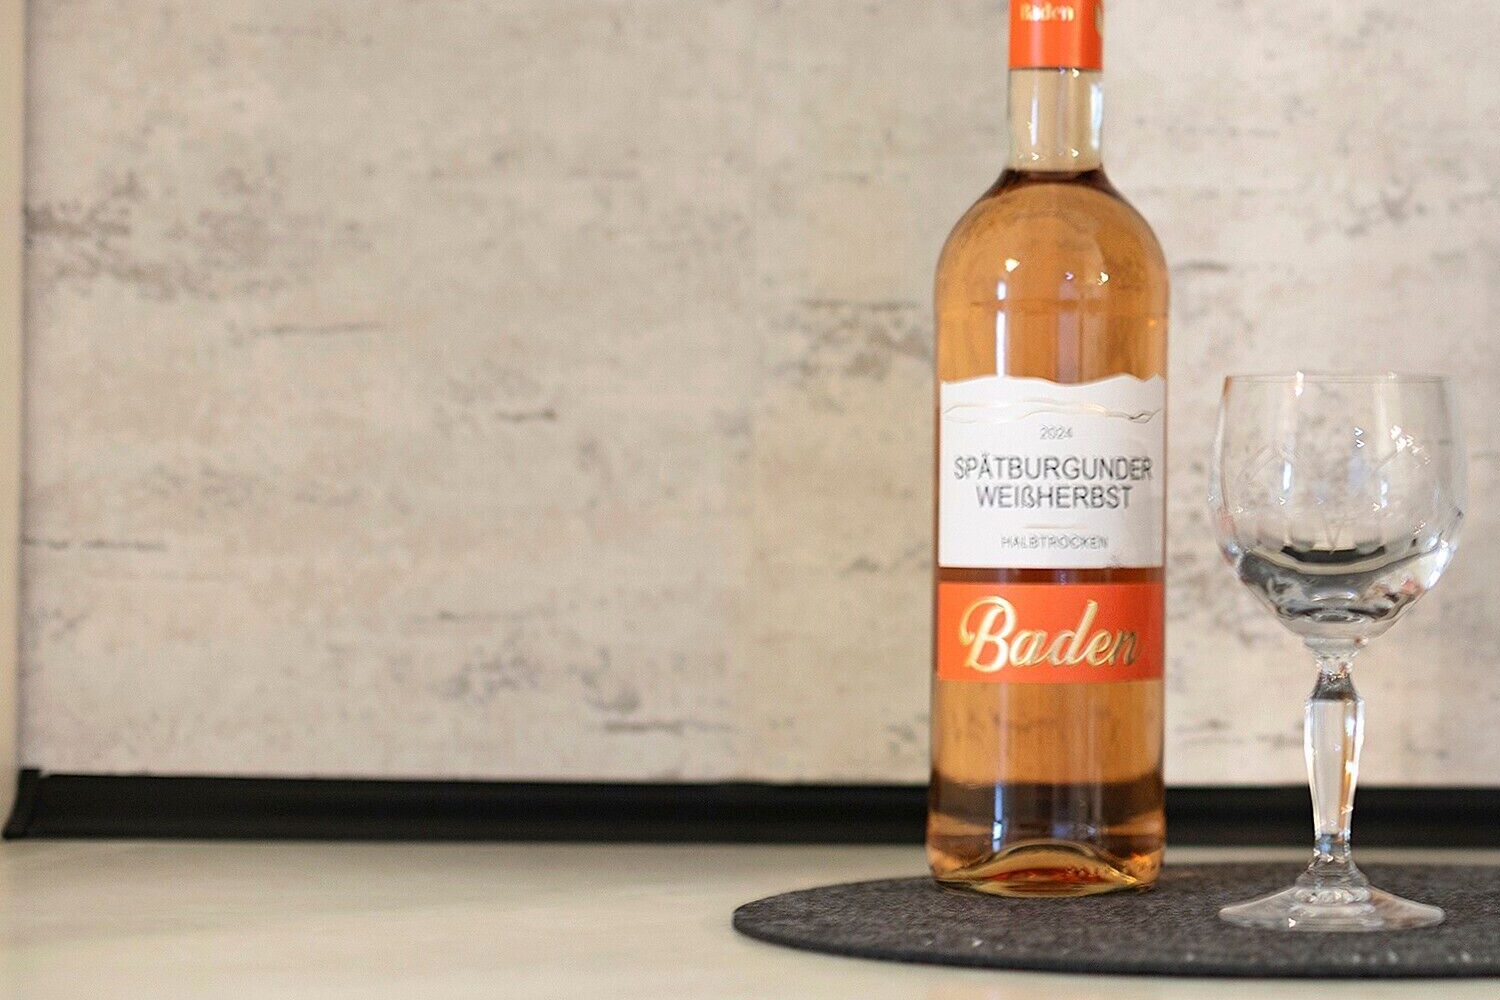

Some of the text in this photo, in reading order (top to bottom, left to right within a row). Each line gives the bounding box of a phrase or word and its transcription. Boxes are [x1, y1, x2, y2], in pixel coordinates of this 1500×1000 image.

[1040, 425, 1073, 440] 2024
[954, 453, 1153, 481] SPÄTBURGUNDER
[1001, 536, 1109, 550] HALBTROCKEN
[959, 595, 1141, 674] Baden
